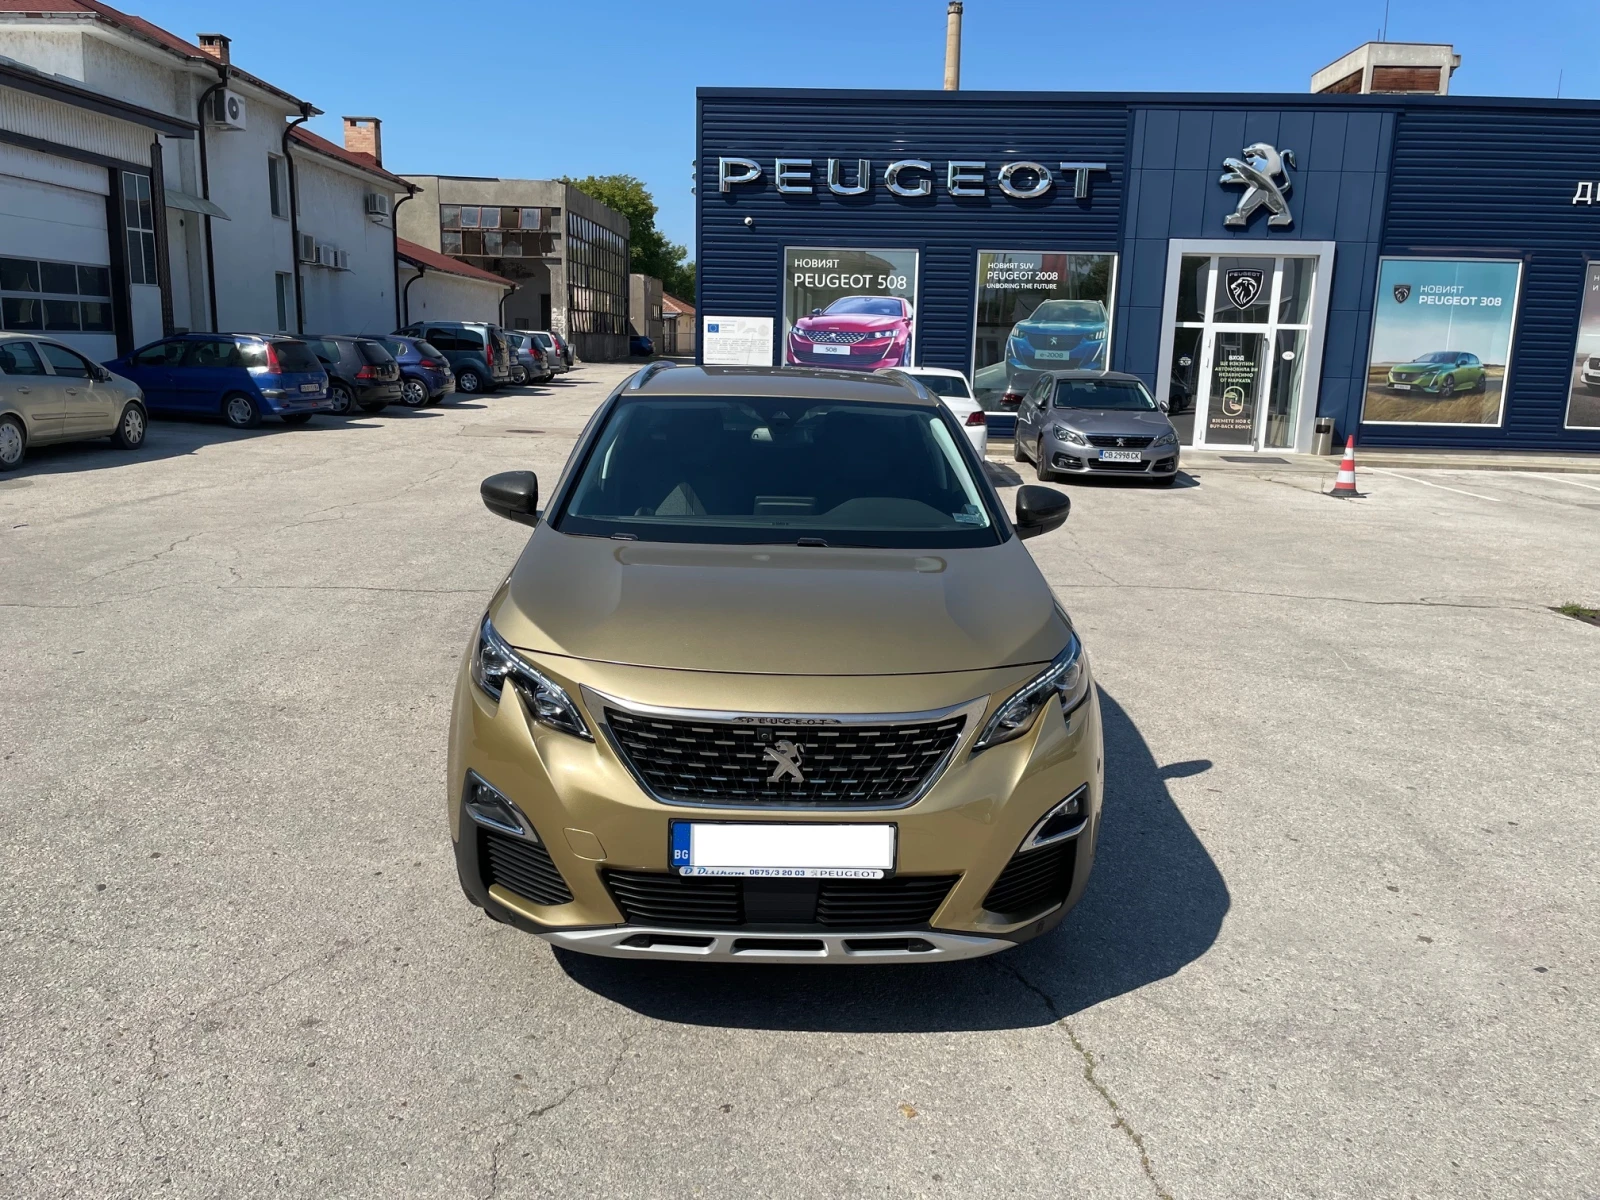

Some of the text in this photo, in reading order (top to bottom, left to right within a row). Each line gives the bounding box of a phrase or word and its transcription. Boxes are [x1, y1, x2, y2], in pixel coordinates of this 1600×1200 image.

[718, 156, 1107, 199] PEUGEOT
[794, 258, 840, 269] НОВИЯТ
[987, 262, 1034, 270] НОВИЯТ SUV
[794, 273, 907, 290] PEUGEOT 508
[986, 271, 1059, 281] PEUGEOT 2008
[1420, 284, 1464, 294] НОВИЯТ
[1418, 295, 1502, 307] PEUGEOT 308
[674, 849, 689, 860] BG
[749, 868, 780, 876] 0675/3
[794, 869, 806, 877] 03
[819, 870, 878, 878] PEUGEOT
